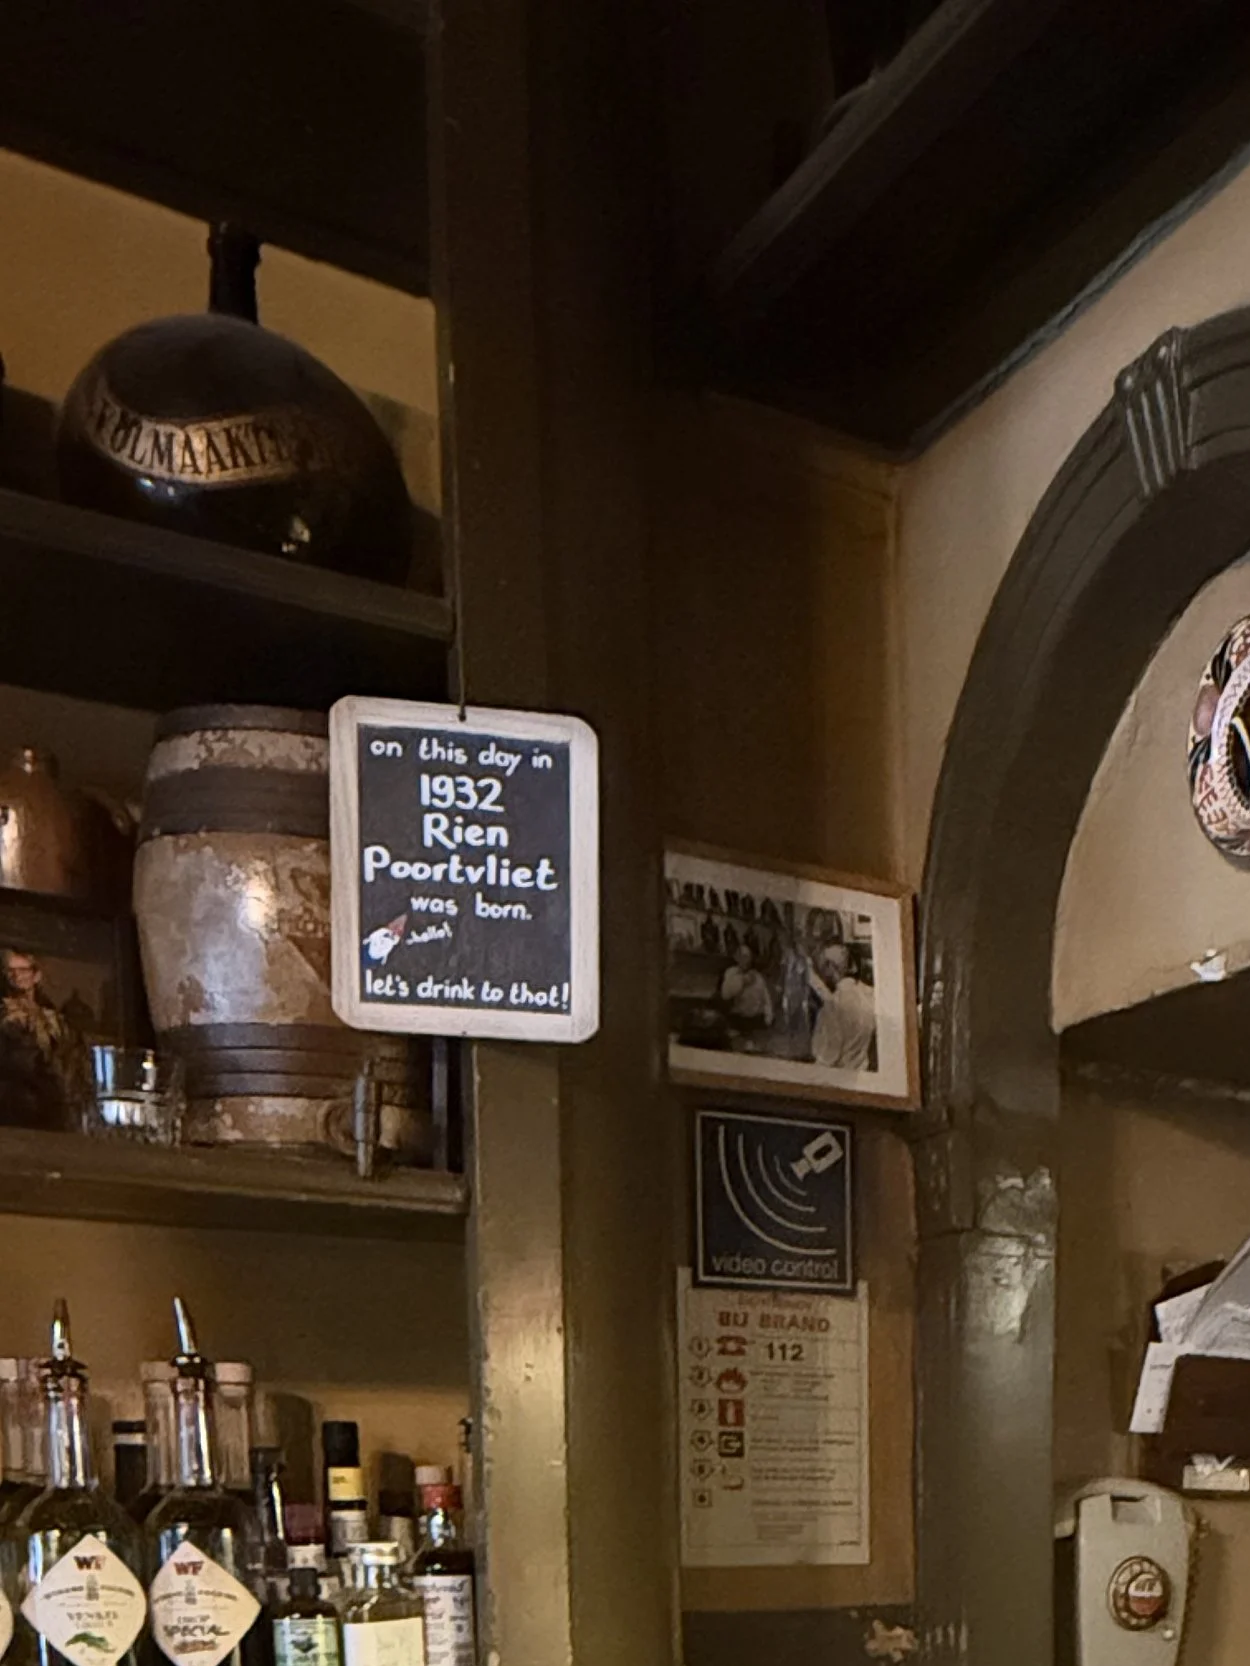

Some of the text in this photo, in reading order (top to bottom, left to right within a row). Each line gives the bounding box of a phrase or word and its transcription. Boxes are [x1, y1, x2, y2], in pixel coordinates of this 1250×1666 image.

[369, 736, 553, 777] on this day in
[419, 773, 506, 813] 1932
[422, 812, 509, 850] Rien
[362, 844, 559, 892] Poortvliet
[409, 891, 533, 921] was born.
[365, 969, 570, 1011] let's drink to that!
[711, 1252, 839, 1280] video control
[758, 1313, 831, 1333] BRAND
[765, 1342, 806, 1362] 112
[173, 1560, 205, 1576] WF
